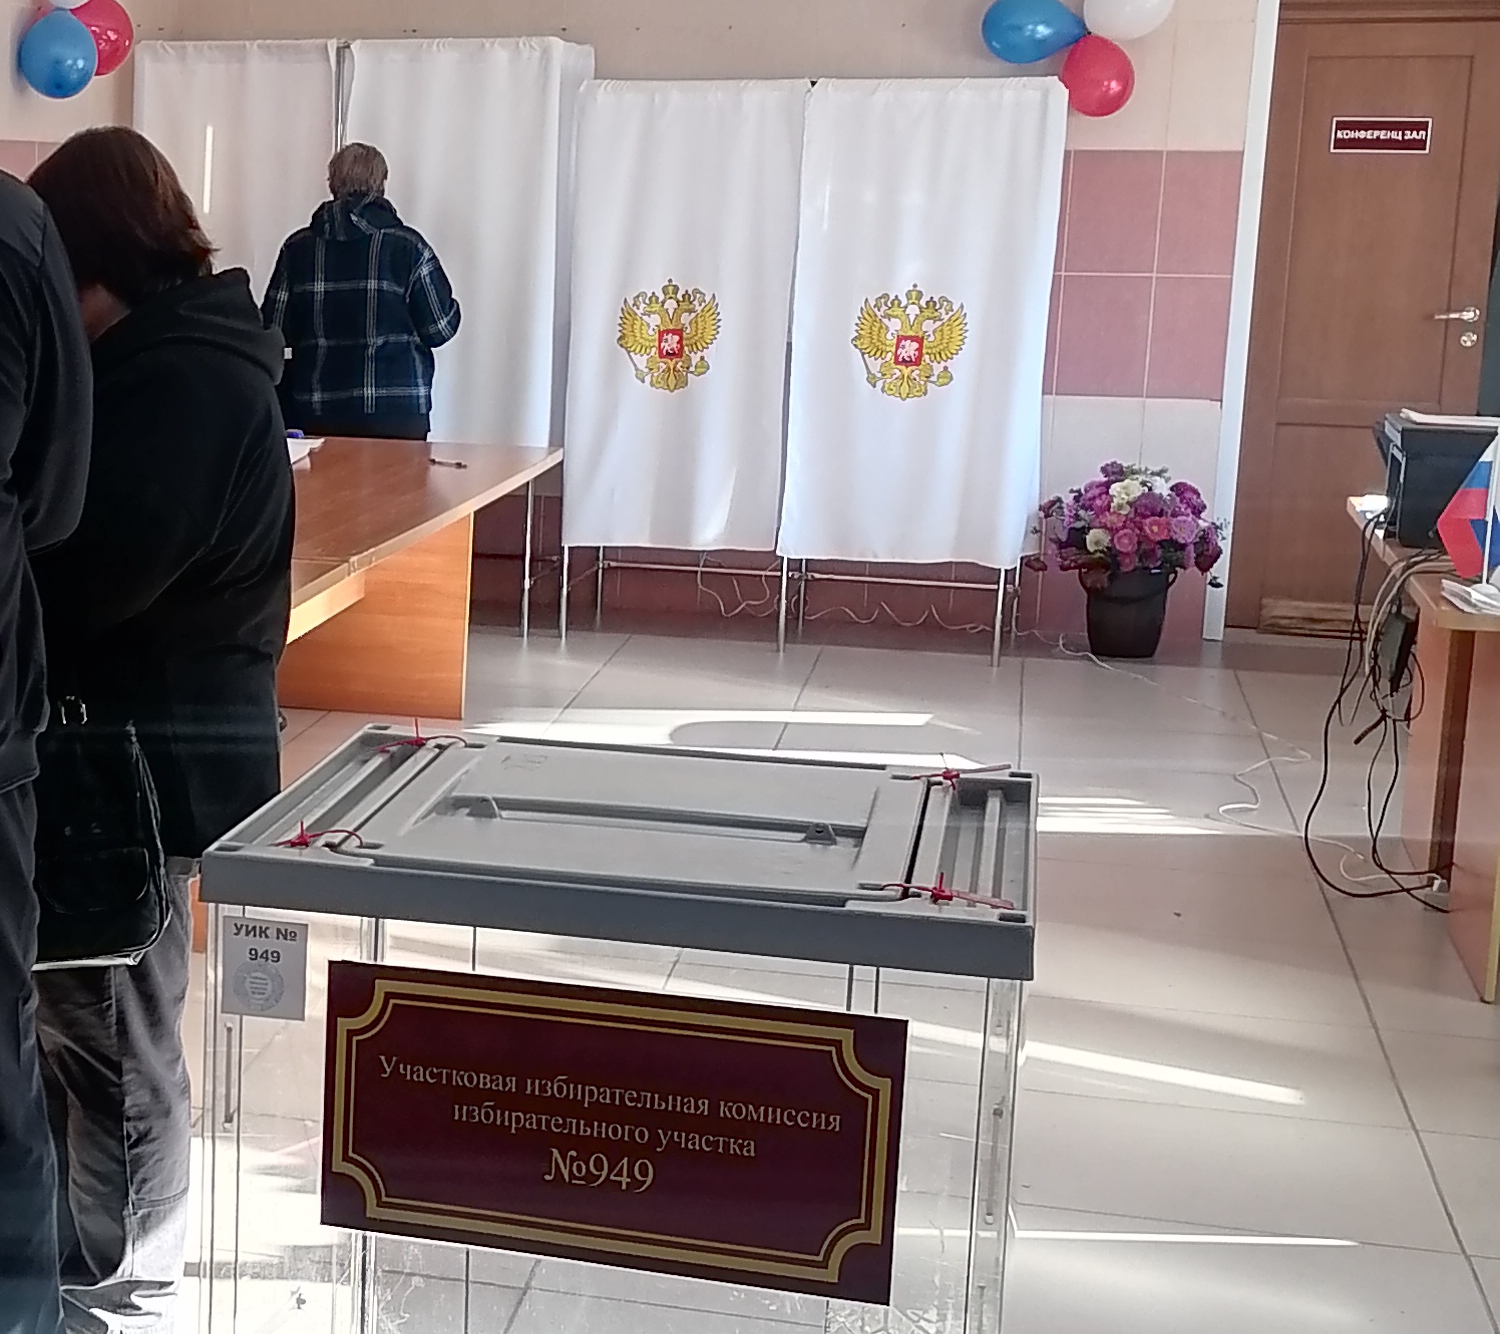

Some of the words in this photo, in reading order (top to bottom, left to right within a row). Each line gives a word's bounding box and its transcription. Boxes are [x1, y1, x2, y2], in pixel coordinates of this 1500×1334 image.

[1336, 129, 1403, 141] КОНФЕРЕНЦ
[1404, 130, 1427, 141] ЗАЛ
[233, 922, 270, 940] УИК
[275, 927, 298, 942] №
[248, 947, 281, 963] 949
[378, 1054, 517, 1094] Участковая
[524, 1075, 710, 1117] избирательная
[719, 1099, 842, 1133] комиссия
[453, 1101, 650, 1144] избирательного
[655, 1128, 757, 1158] участка
[543, 1147, 654, 1194] №949
